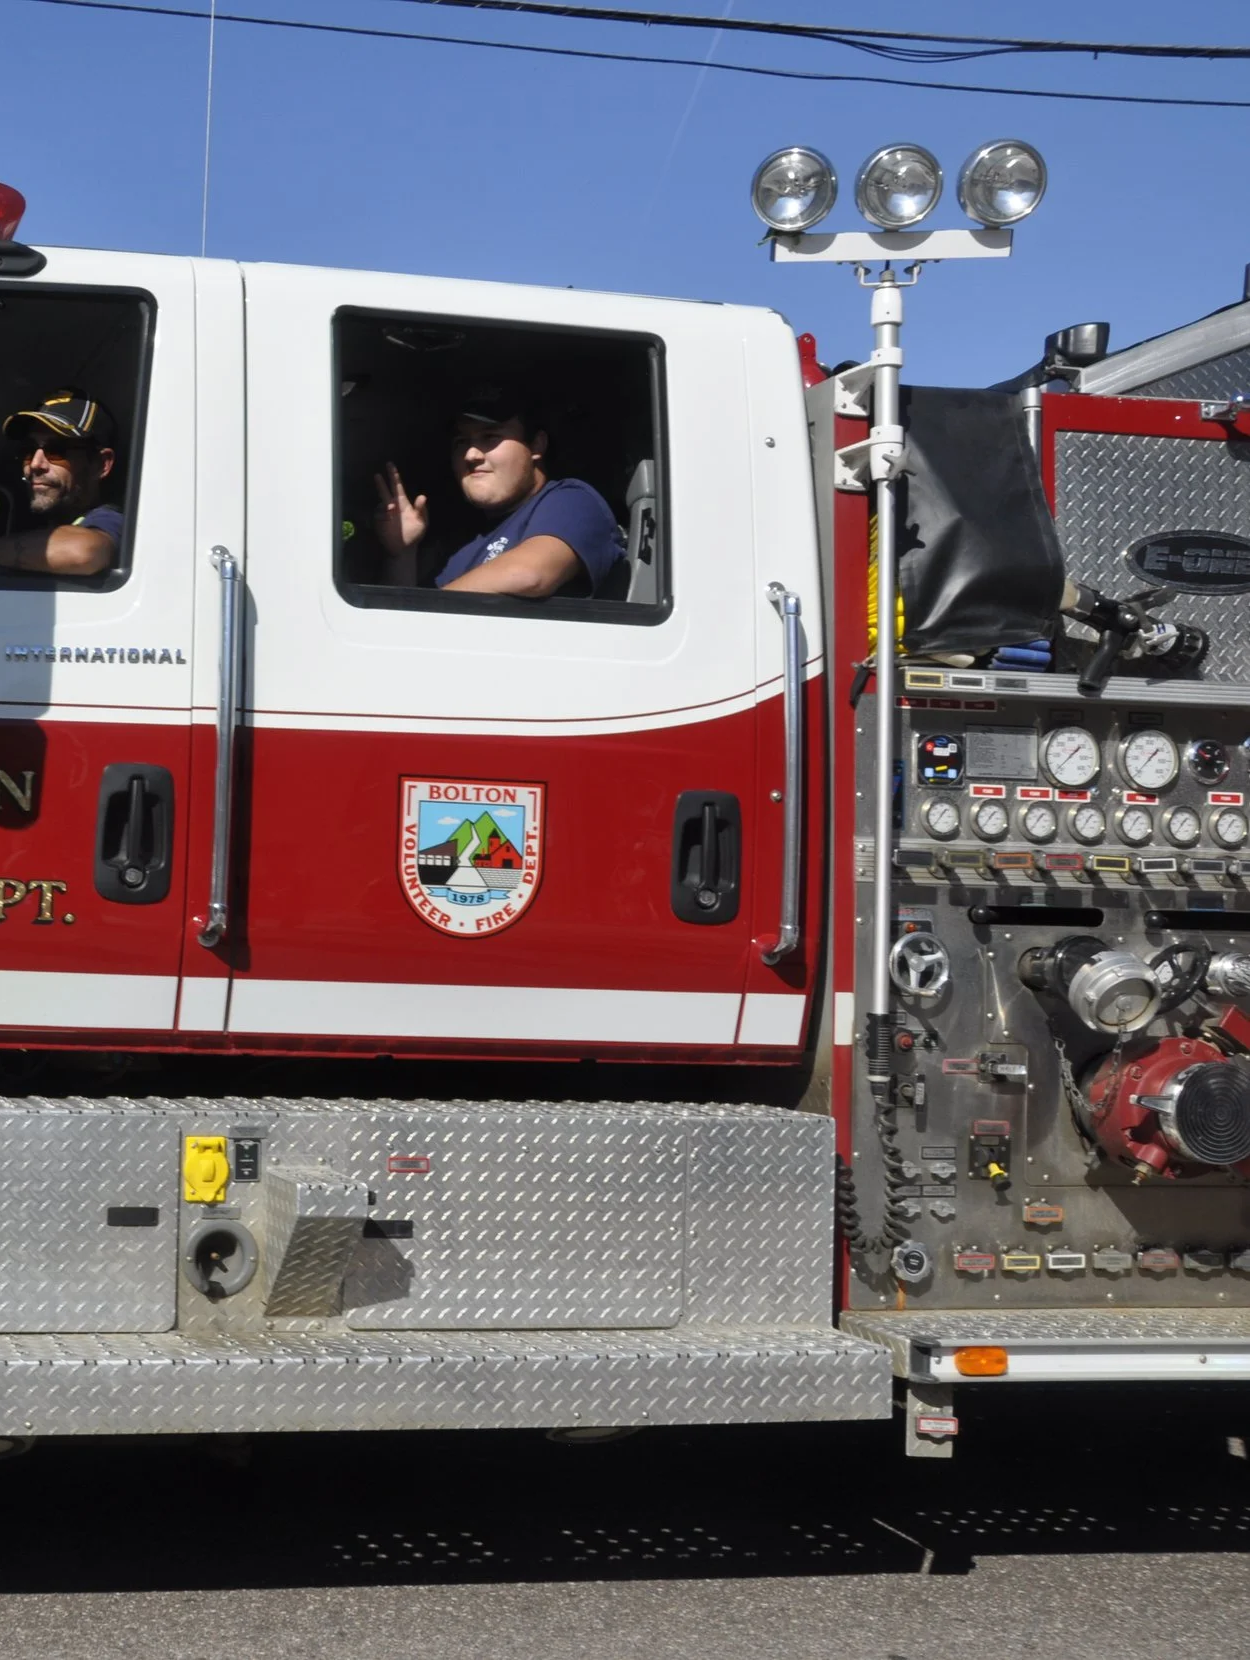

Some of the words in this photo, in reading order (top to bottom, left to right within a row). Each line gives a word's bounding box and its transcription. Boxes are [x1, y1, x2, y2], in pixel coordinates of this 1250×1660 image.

[4, 645, 187, 665] INTERNATIONAL
[429, 784, 517, 803] BOLTON
[403, 823, 452, 928] VOLUNTEER
[475, 902, 517, 931] FIRE
[452, 893, 486, 905] 1978
